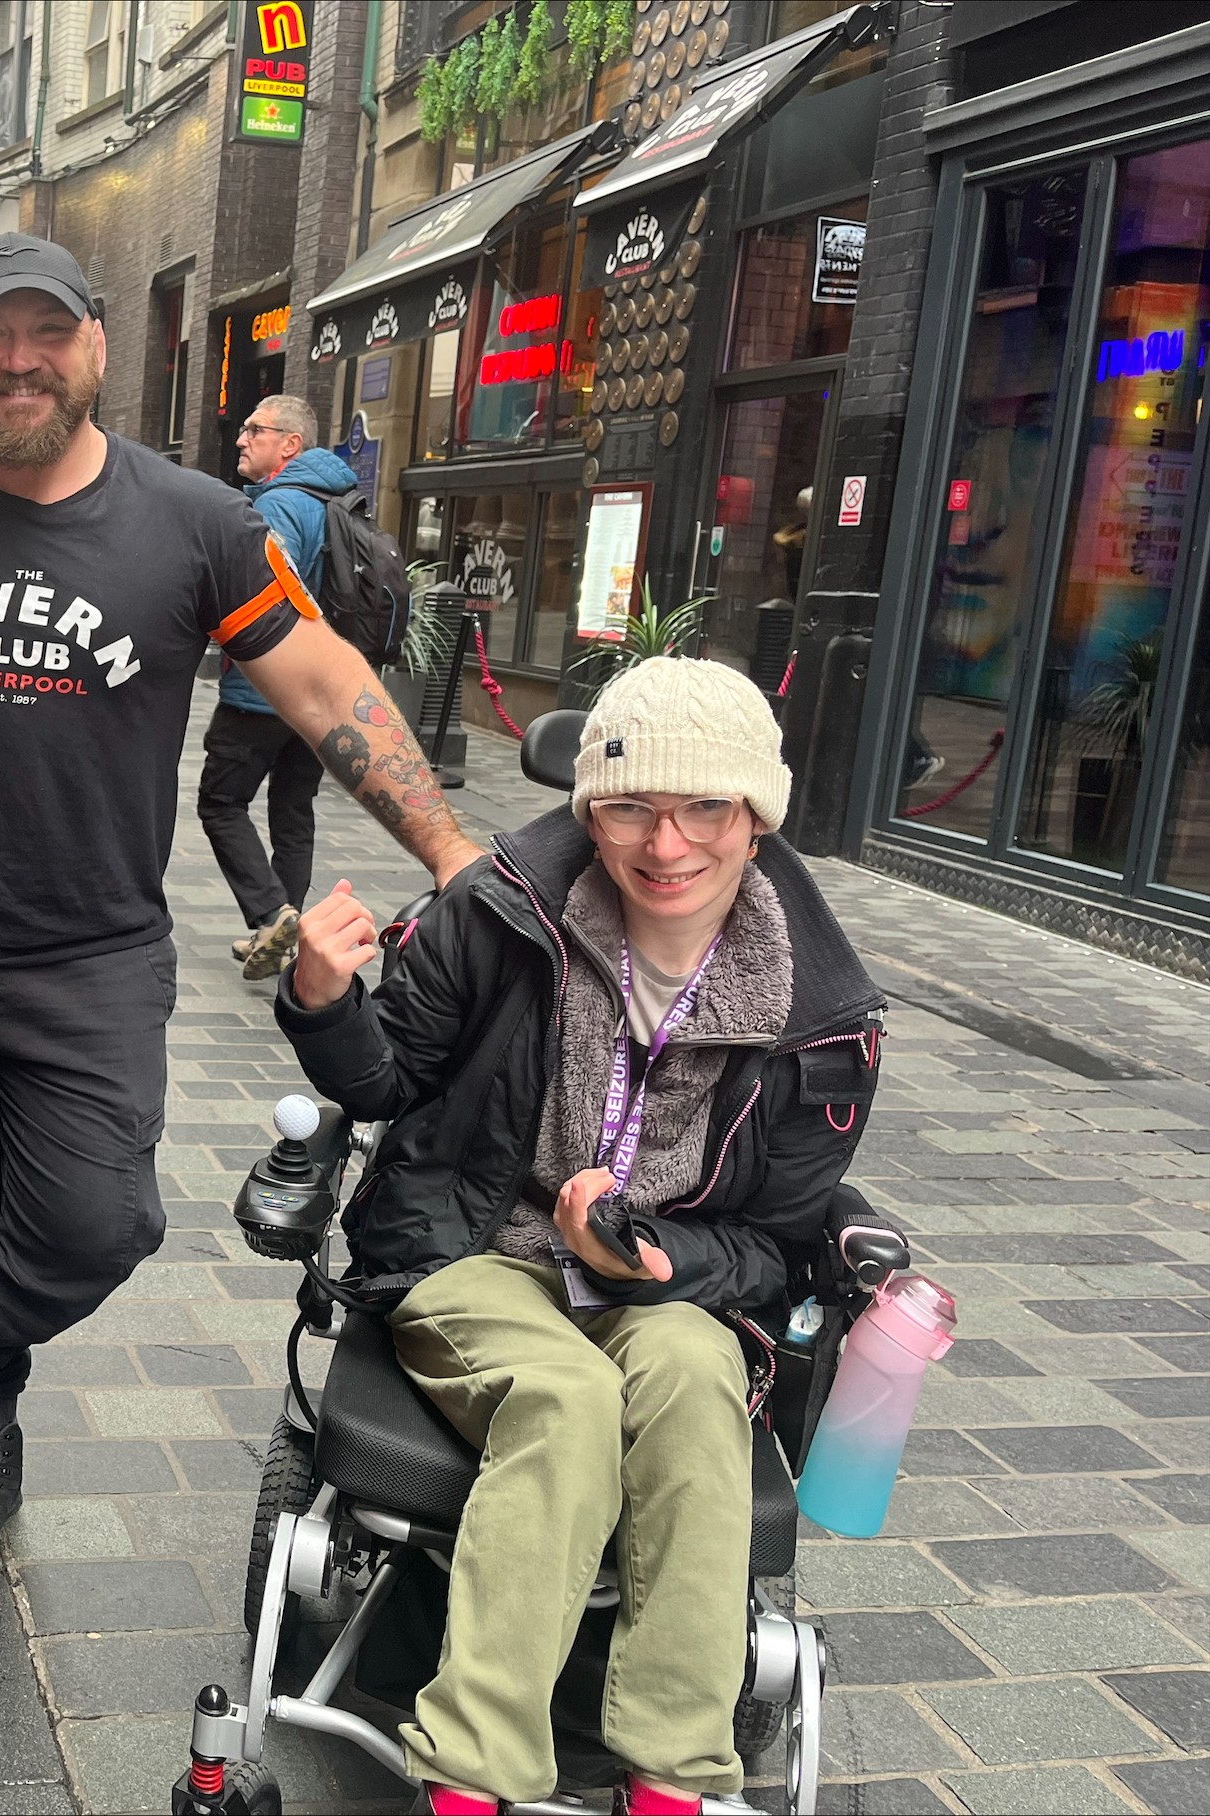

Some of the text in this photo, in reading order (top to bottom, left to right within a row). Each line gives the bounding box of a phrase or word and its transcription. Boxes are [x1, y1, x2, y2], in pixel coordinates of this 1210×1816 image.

[245, 58, 306, 81] PUB
[247, 81, 301, 95] LIVERPOOL
[246, 118, 297, 133] Heineken
[605, 213, 665, 275] CAVERN
[621, 242, 650, 264] CLUB
[428, 280, 468, 329] CAVERN
[15, 569, 44, 580] THE
[454, 539, 515, 604] CAVERN
[470, 577, 498, 596] CLUB
[11, 693, 38, 705] 1957
